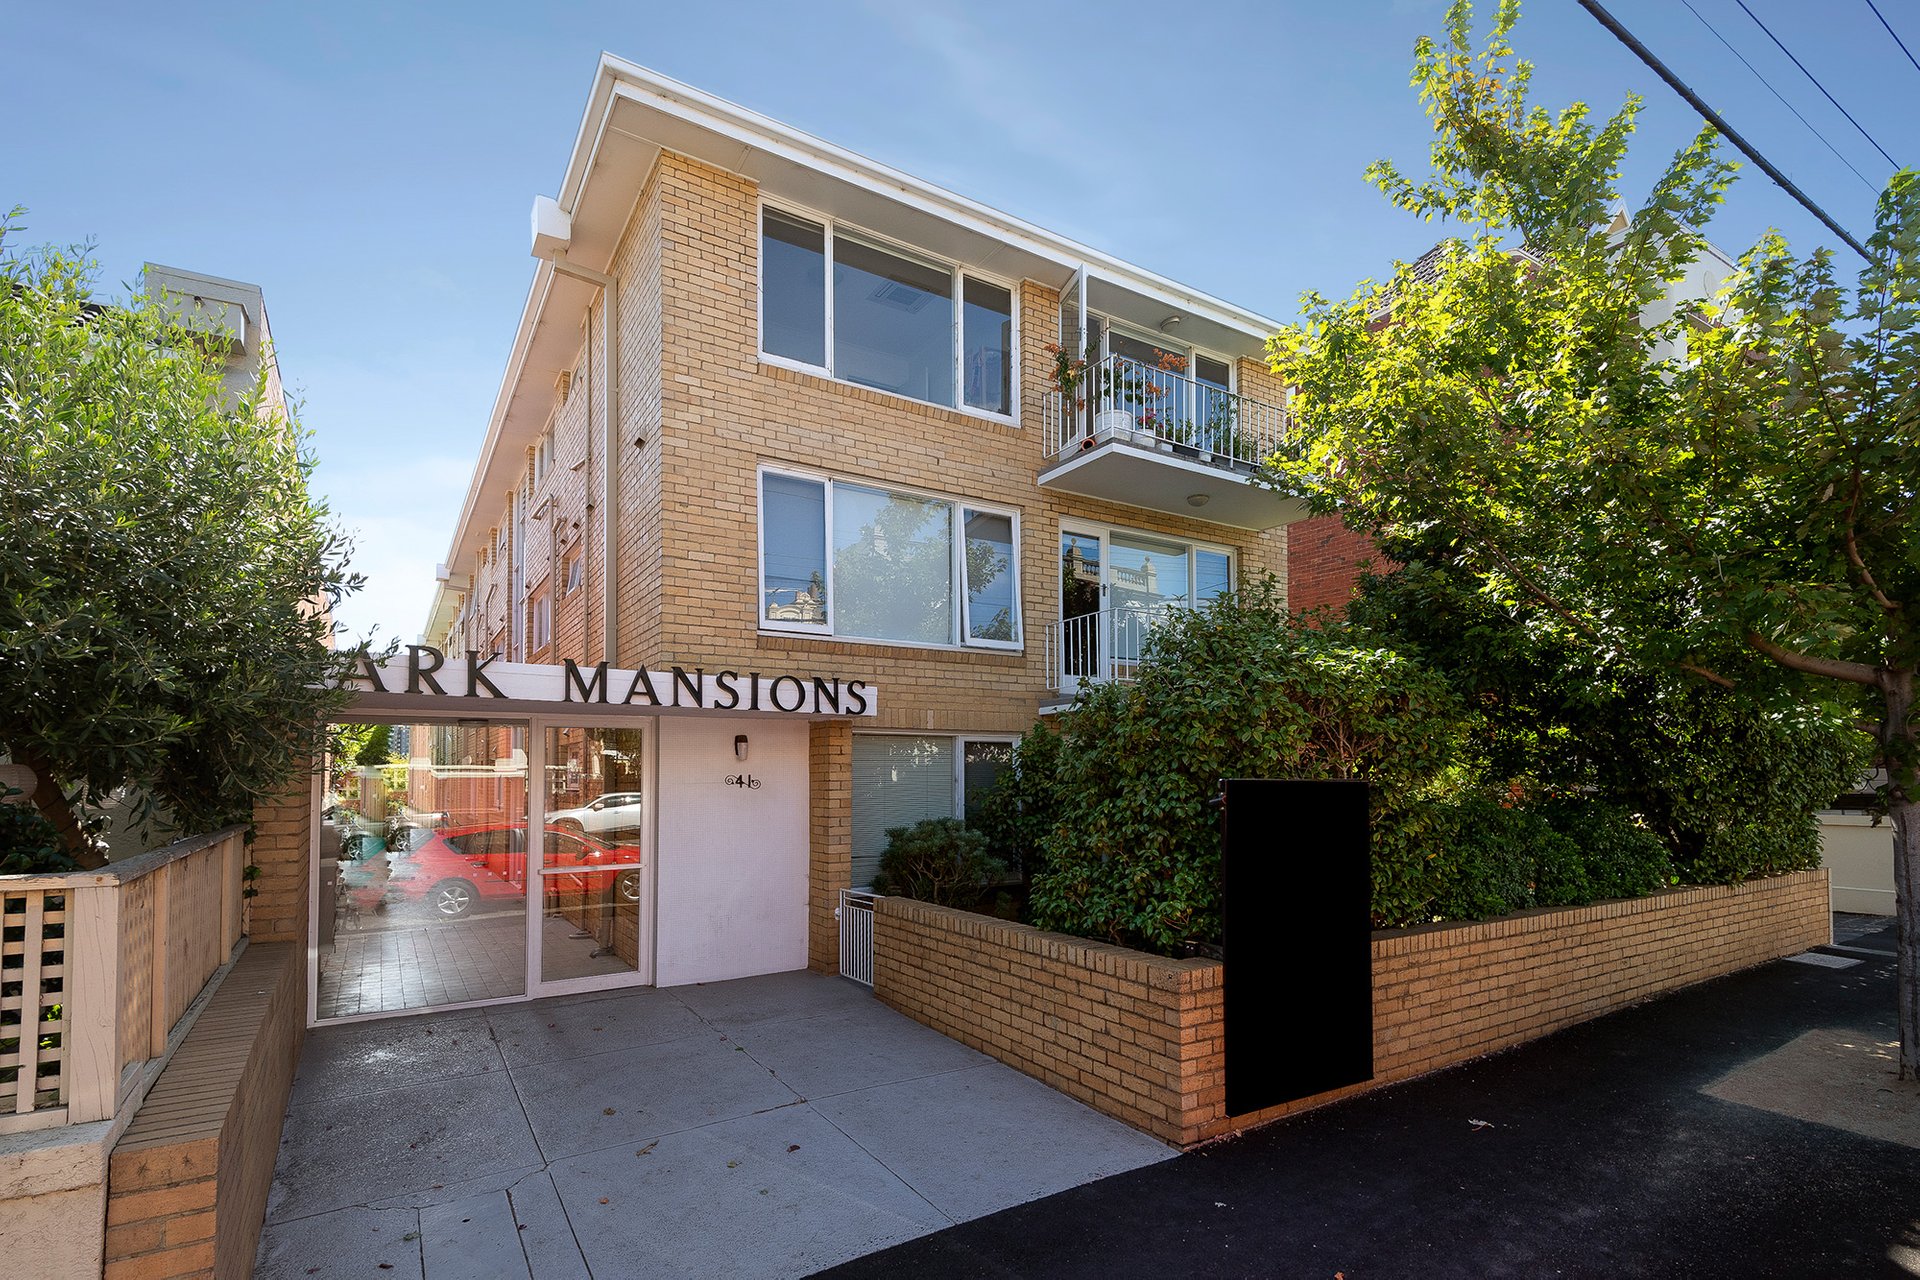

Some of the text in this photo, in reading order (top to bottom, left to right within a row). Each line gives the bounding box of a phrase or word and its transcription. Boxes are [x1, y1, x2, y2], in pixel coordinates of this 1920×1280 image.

[333, 644, 867, 715] ARK MANSIONS
[735, 774, 751, 788] 41
